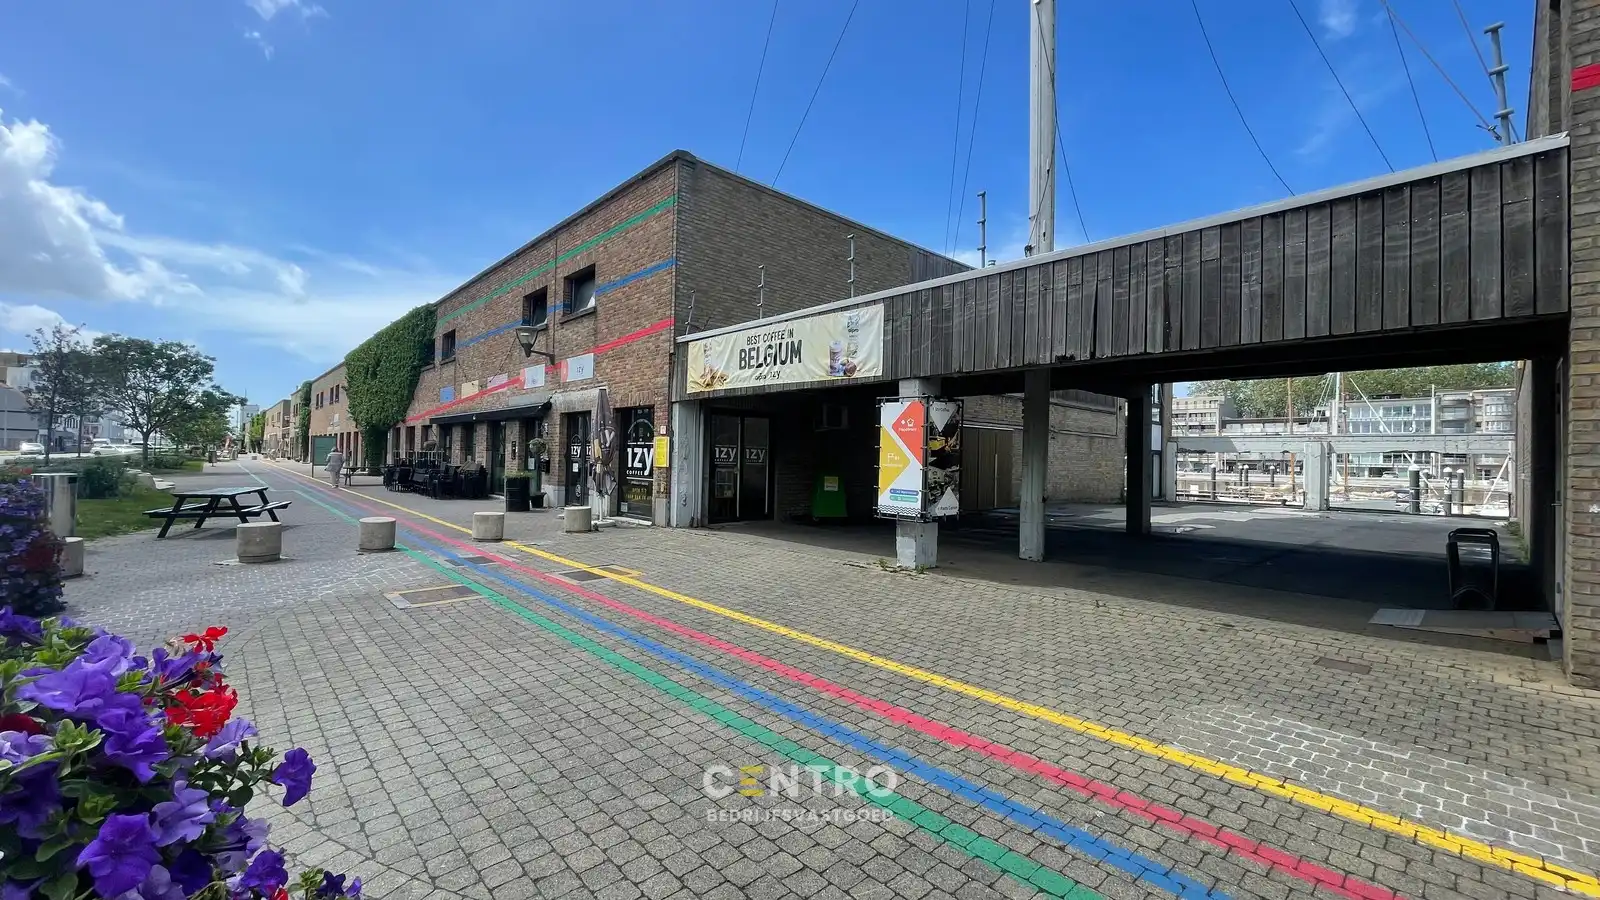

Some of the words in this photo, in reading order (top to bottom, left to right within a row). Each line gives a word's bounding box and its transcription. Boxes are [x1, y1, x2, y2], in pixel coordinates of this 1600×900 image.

[747, 335, 761, 345] BEST
[763, 330, 785, 343] COFFEE
[787, 328, 794, 338] IN
[739, 339, 802, 370] BELGIUM
